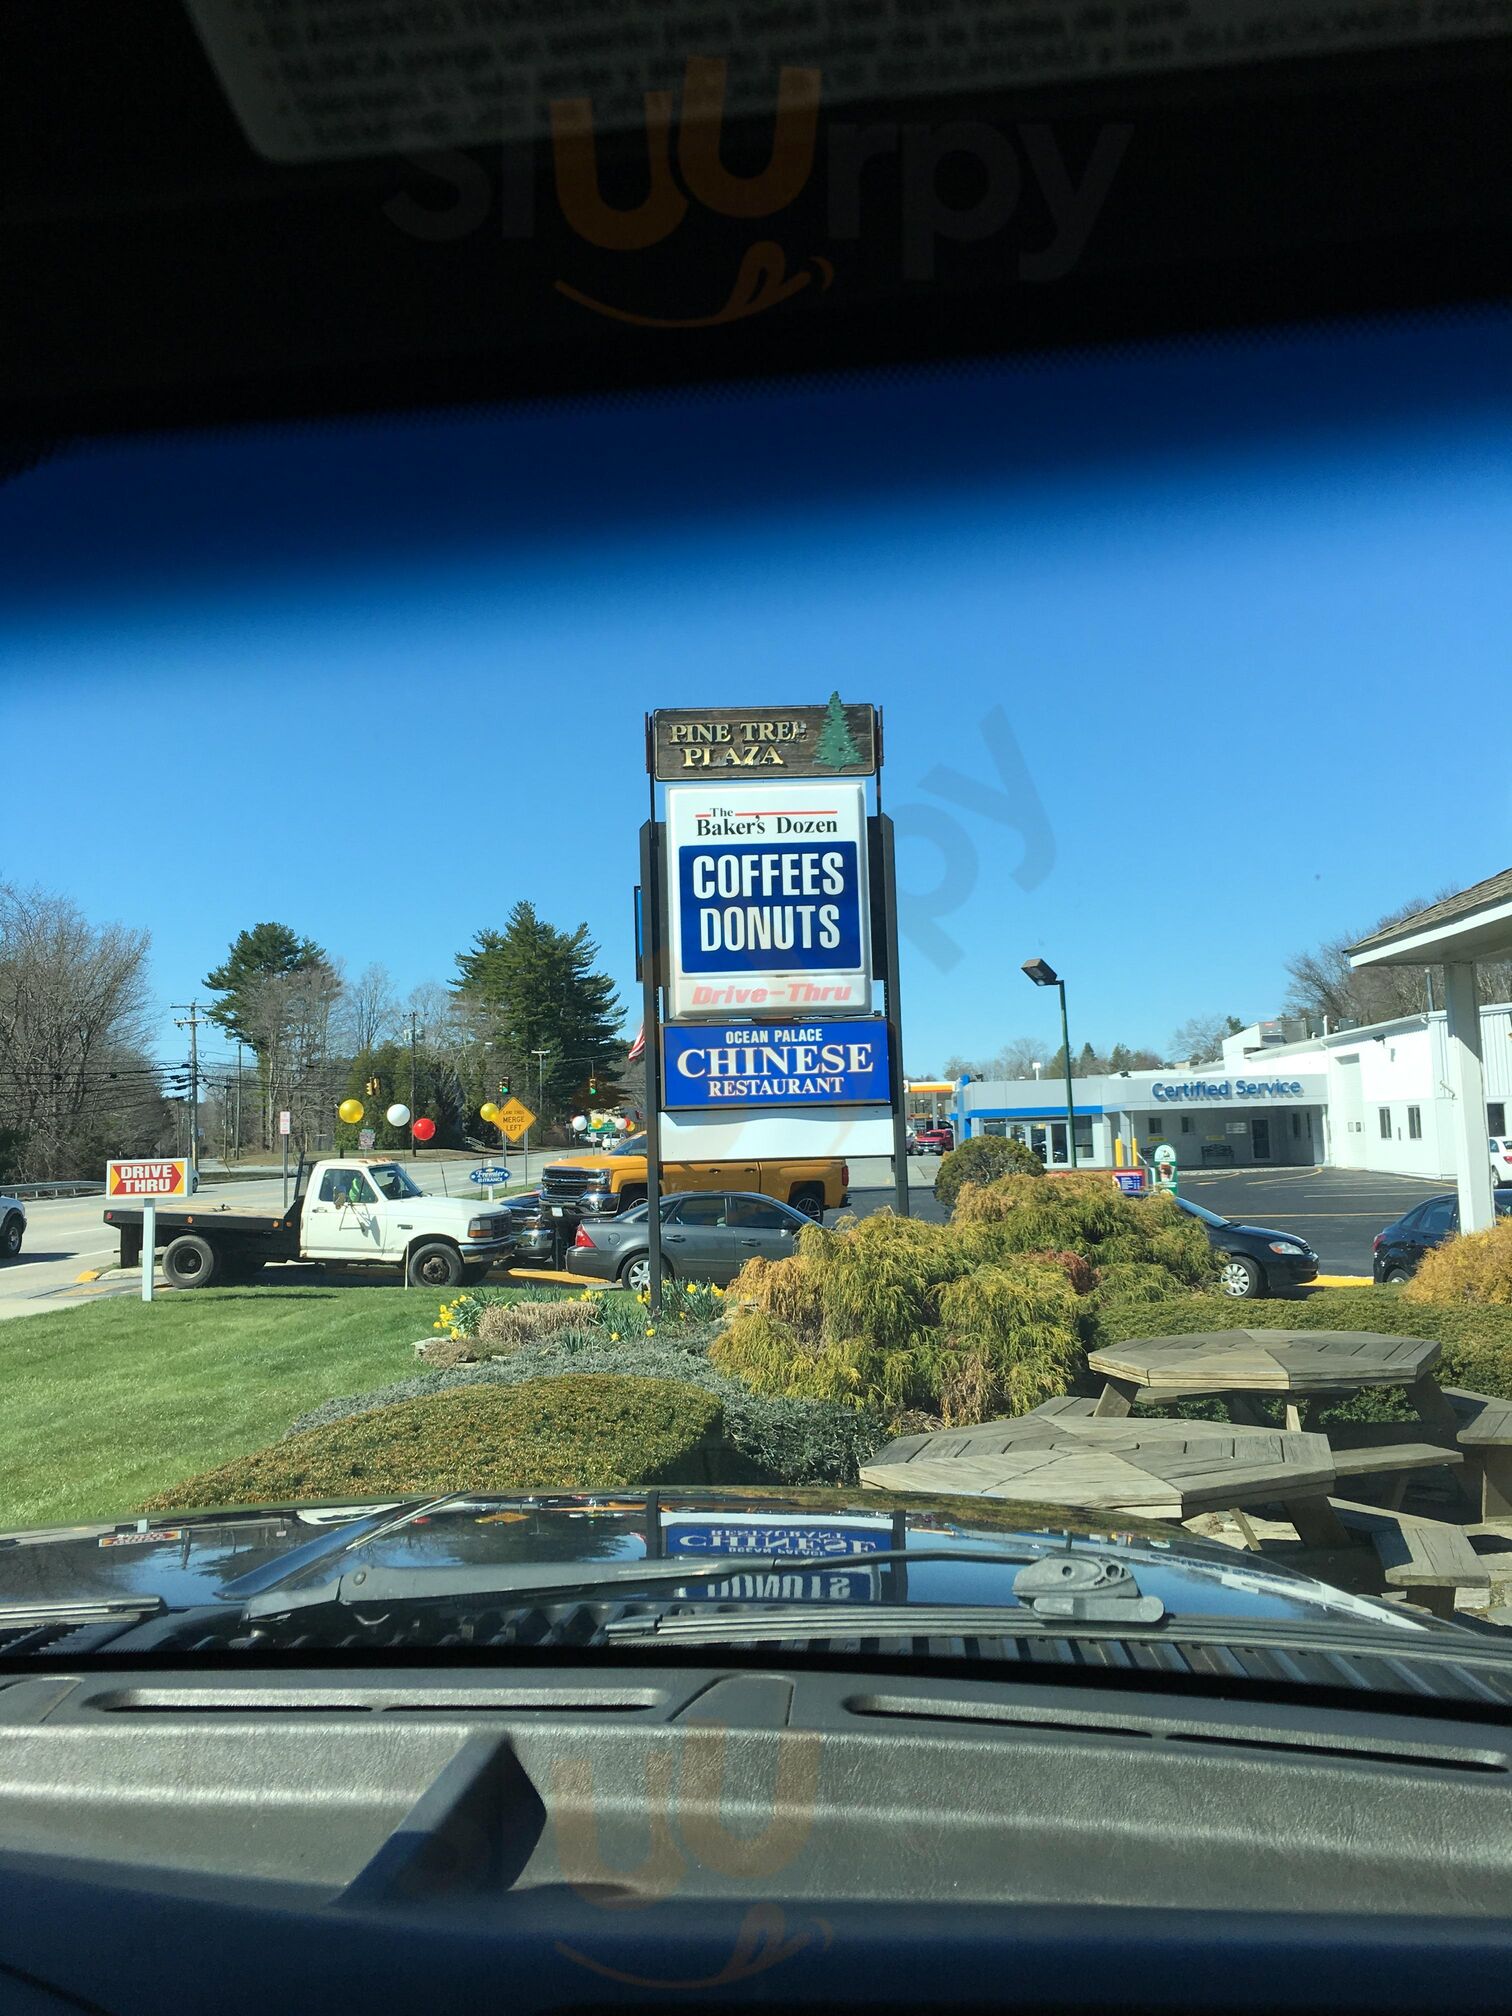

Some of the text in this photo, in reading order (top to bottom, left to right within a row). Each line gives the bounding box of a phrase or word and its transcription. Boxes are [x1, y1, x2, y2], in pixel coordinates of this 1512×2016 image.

[669, 724, 731, 742] PINE
[683, 745, 784, 767] PLAZA
[710, 807, 733, 818] The
[697, 815, 838, 836] Baker's Dozen
[692, 852, 845, 899] COFFEES
[700, 904, 841, 952] DONUTS
[692, 983, 852, 1005] Drive-Thru
[726, 1029, 823, 1044] OCEAN PALACE
[677, 1043, 874, 1079] CHINESE
[708, 1077, 844, 1097] RESTAURANT
[1152, 1079, 1301, 1098] Certified Service
[120, 1165, 173, 1179] DRIVE
[122, 1179, 170, 1192] THRU
